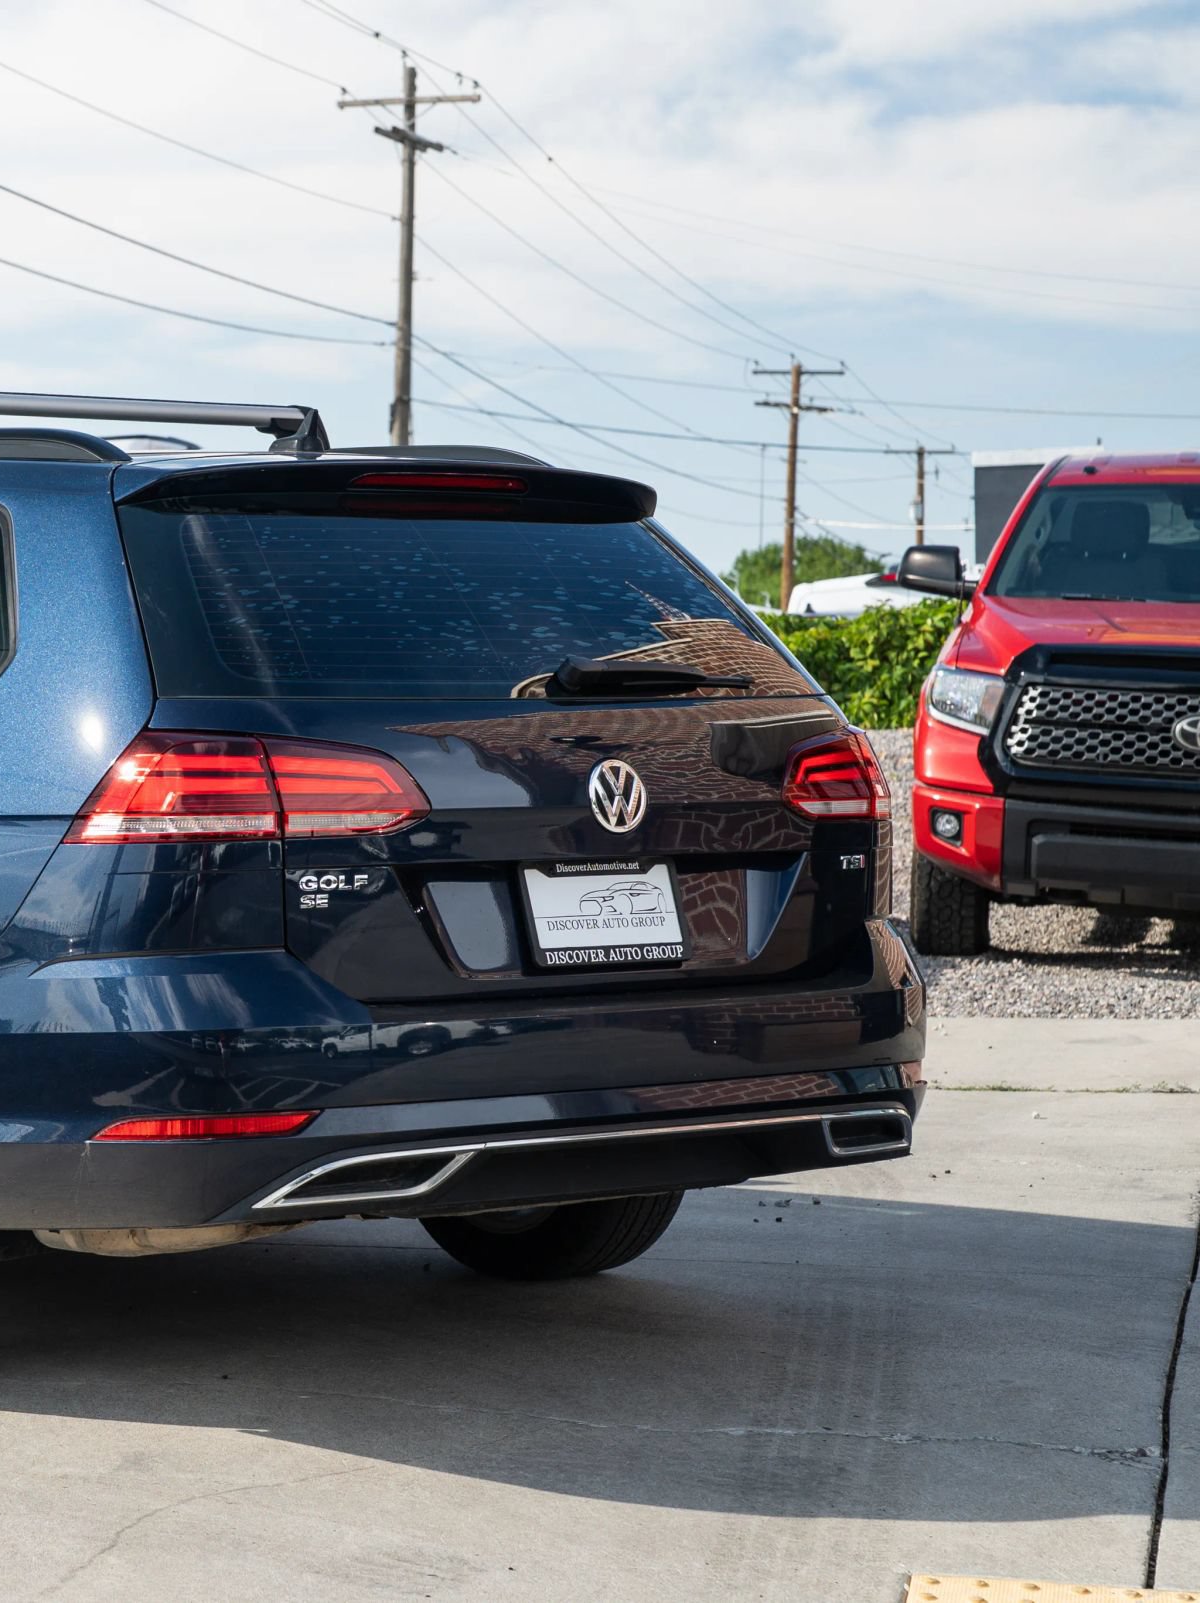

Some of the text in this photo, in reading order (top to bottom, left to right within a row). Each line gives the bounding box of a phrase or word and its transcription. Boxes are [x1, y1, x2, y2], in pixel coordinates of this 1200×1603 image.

[556, 861, 640, 873] DiscoverAutomotive.net
[840, 855, 865, 869] TSI
[299, 874, 369, 892] GOLF
[300, 893, 329, 909] SE
[547, 916, 666, 931] DISCOVER AUTO GROUP
[545, 945, 684, 965] DISCOVER AUTO GROUP
